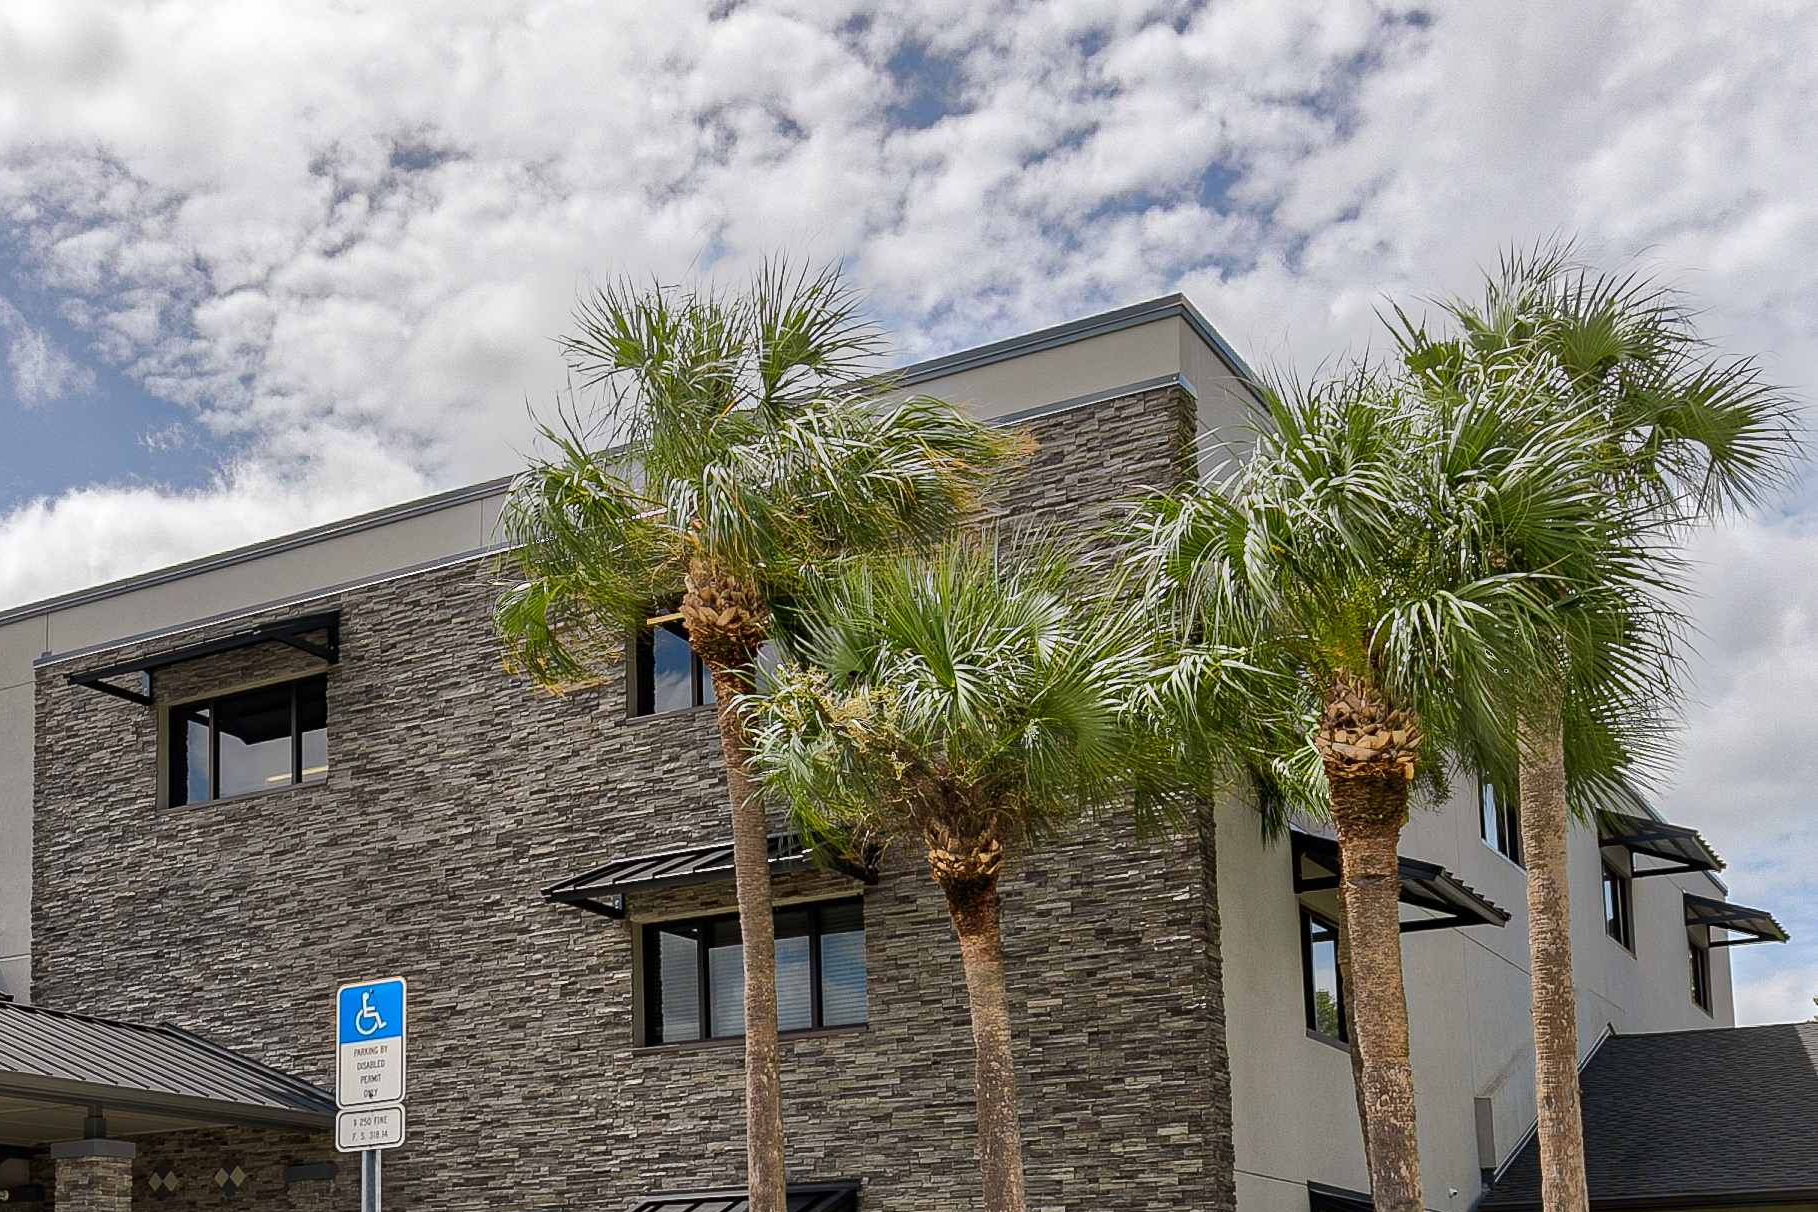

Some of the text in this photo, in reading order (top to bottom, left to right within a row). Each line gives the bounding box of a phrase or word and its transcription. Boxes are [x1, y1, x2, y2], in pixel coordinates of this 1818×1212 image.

[354, 1045, 388, 1057] PARKING BY
[357, 1059, 385, 1070] DISABLED
[360, 1073, 382, 1084] PERMIT
[363, 1088, 379, 1098] ONLY
[359, 1116, 372, 1127] 250
[373, 1115, 388, 1126] FINE
